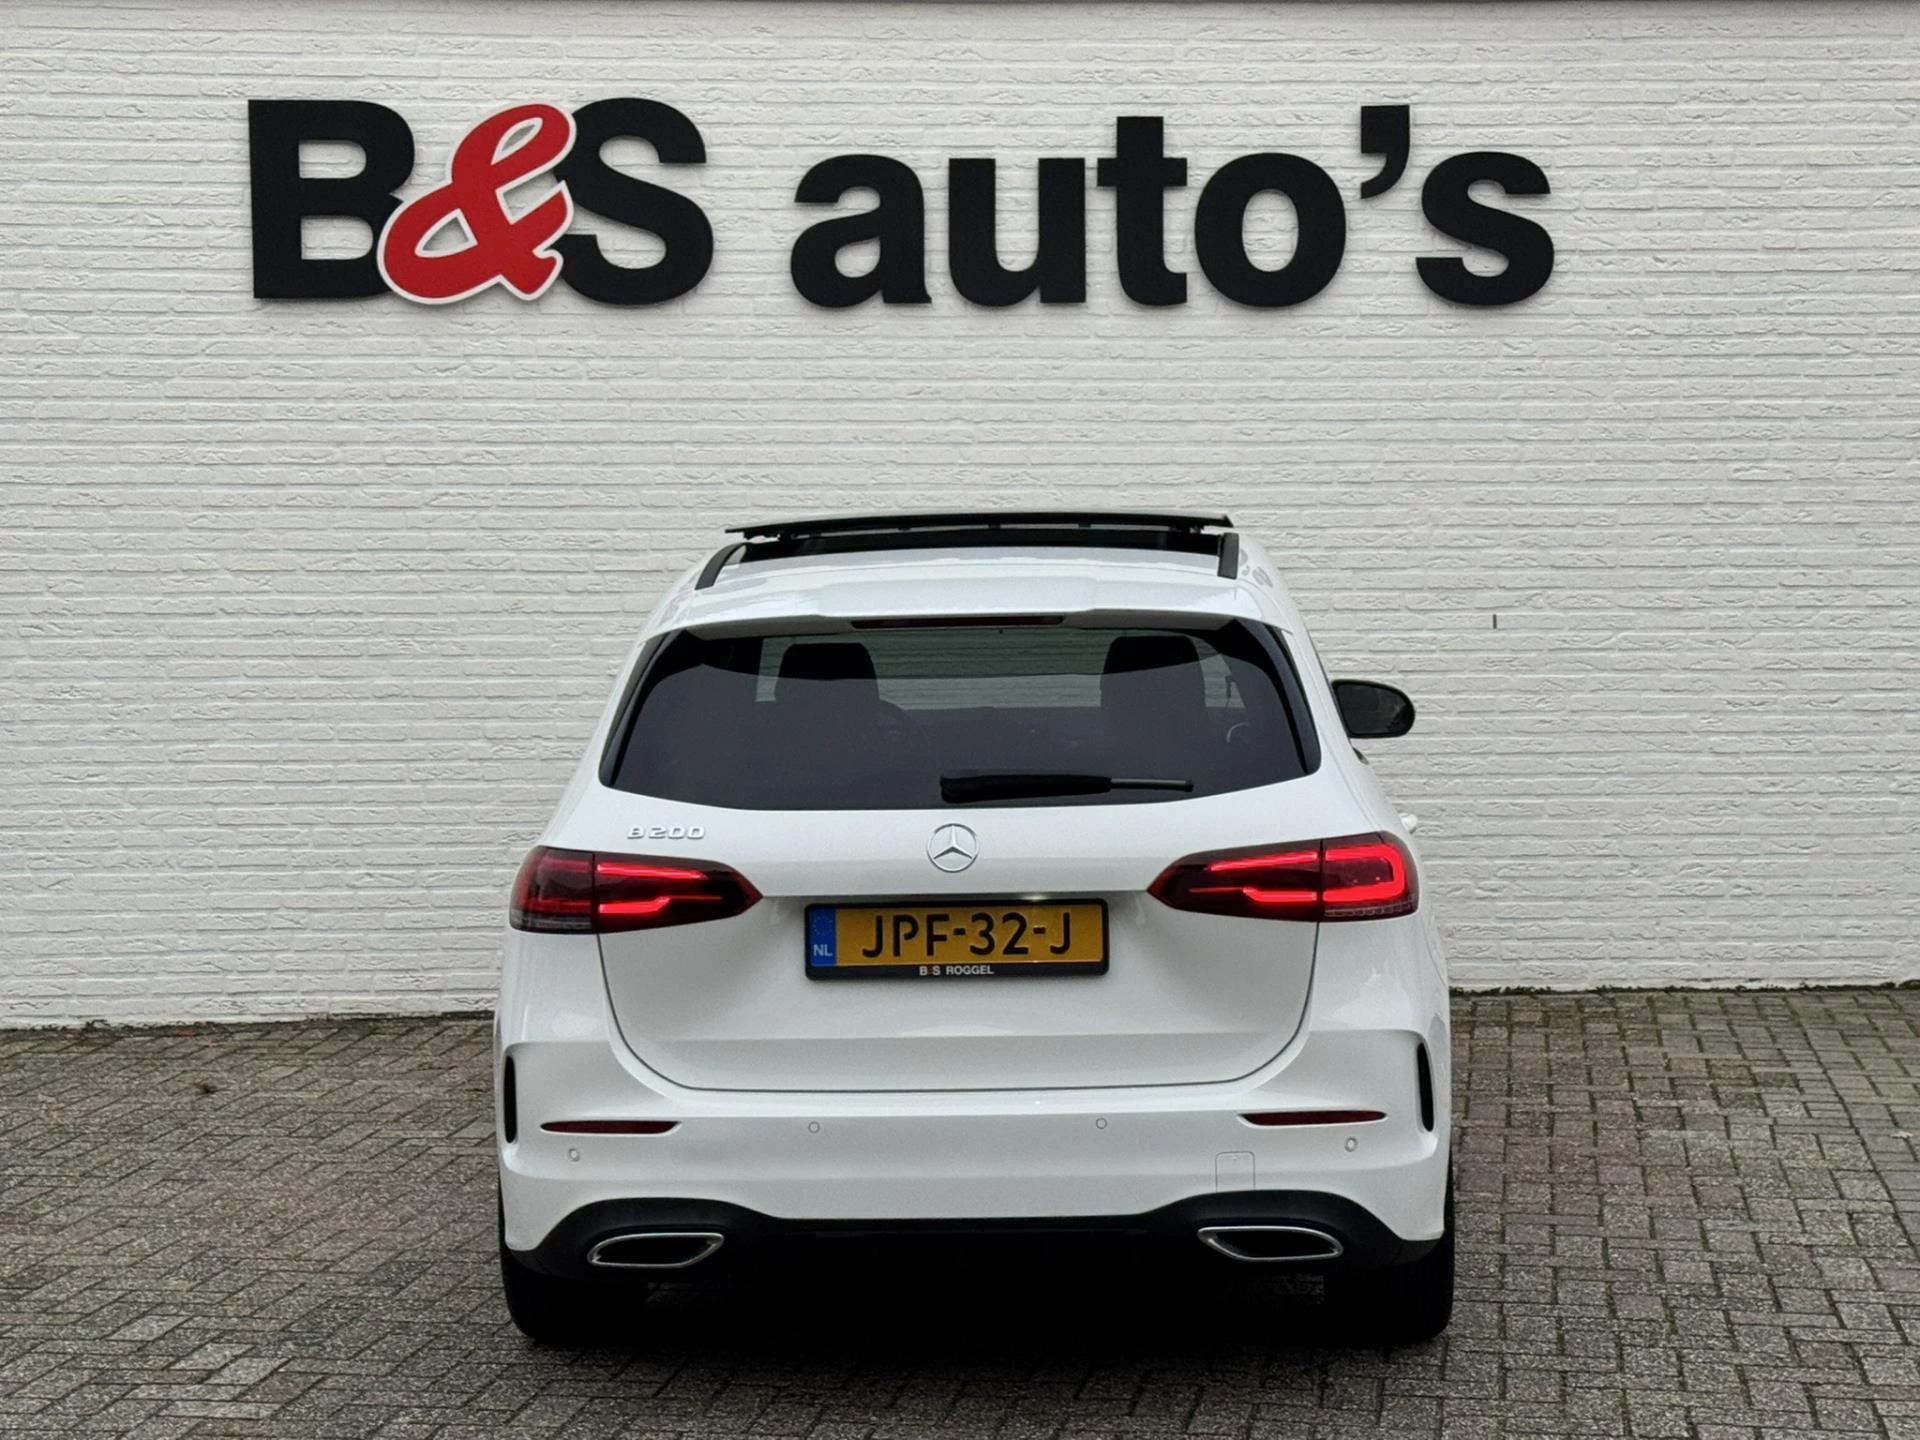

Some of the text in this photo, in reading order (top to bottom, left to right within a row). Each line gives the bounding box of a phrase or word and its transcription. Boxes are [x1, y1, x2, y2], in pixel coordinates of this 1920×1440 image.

[248, 97, 1555, 309] B&S auto's
[861, 911, 1071, 958] JPF-32-J
[813, 944, 833, 957] NL
[945, 964, 995, 975] ROGGEL
